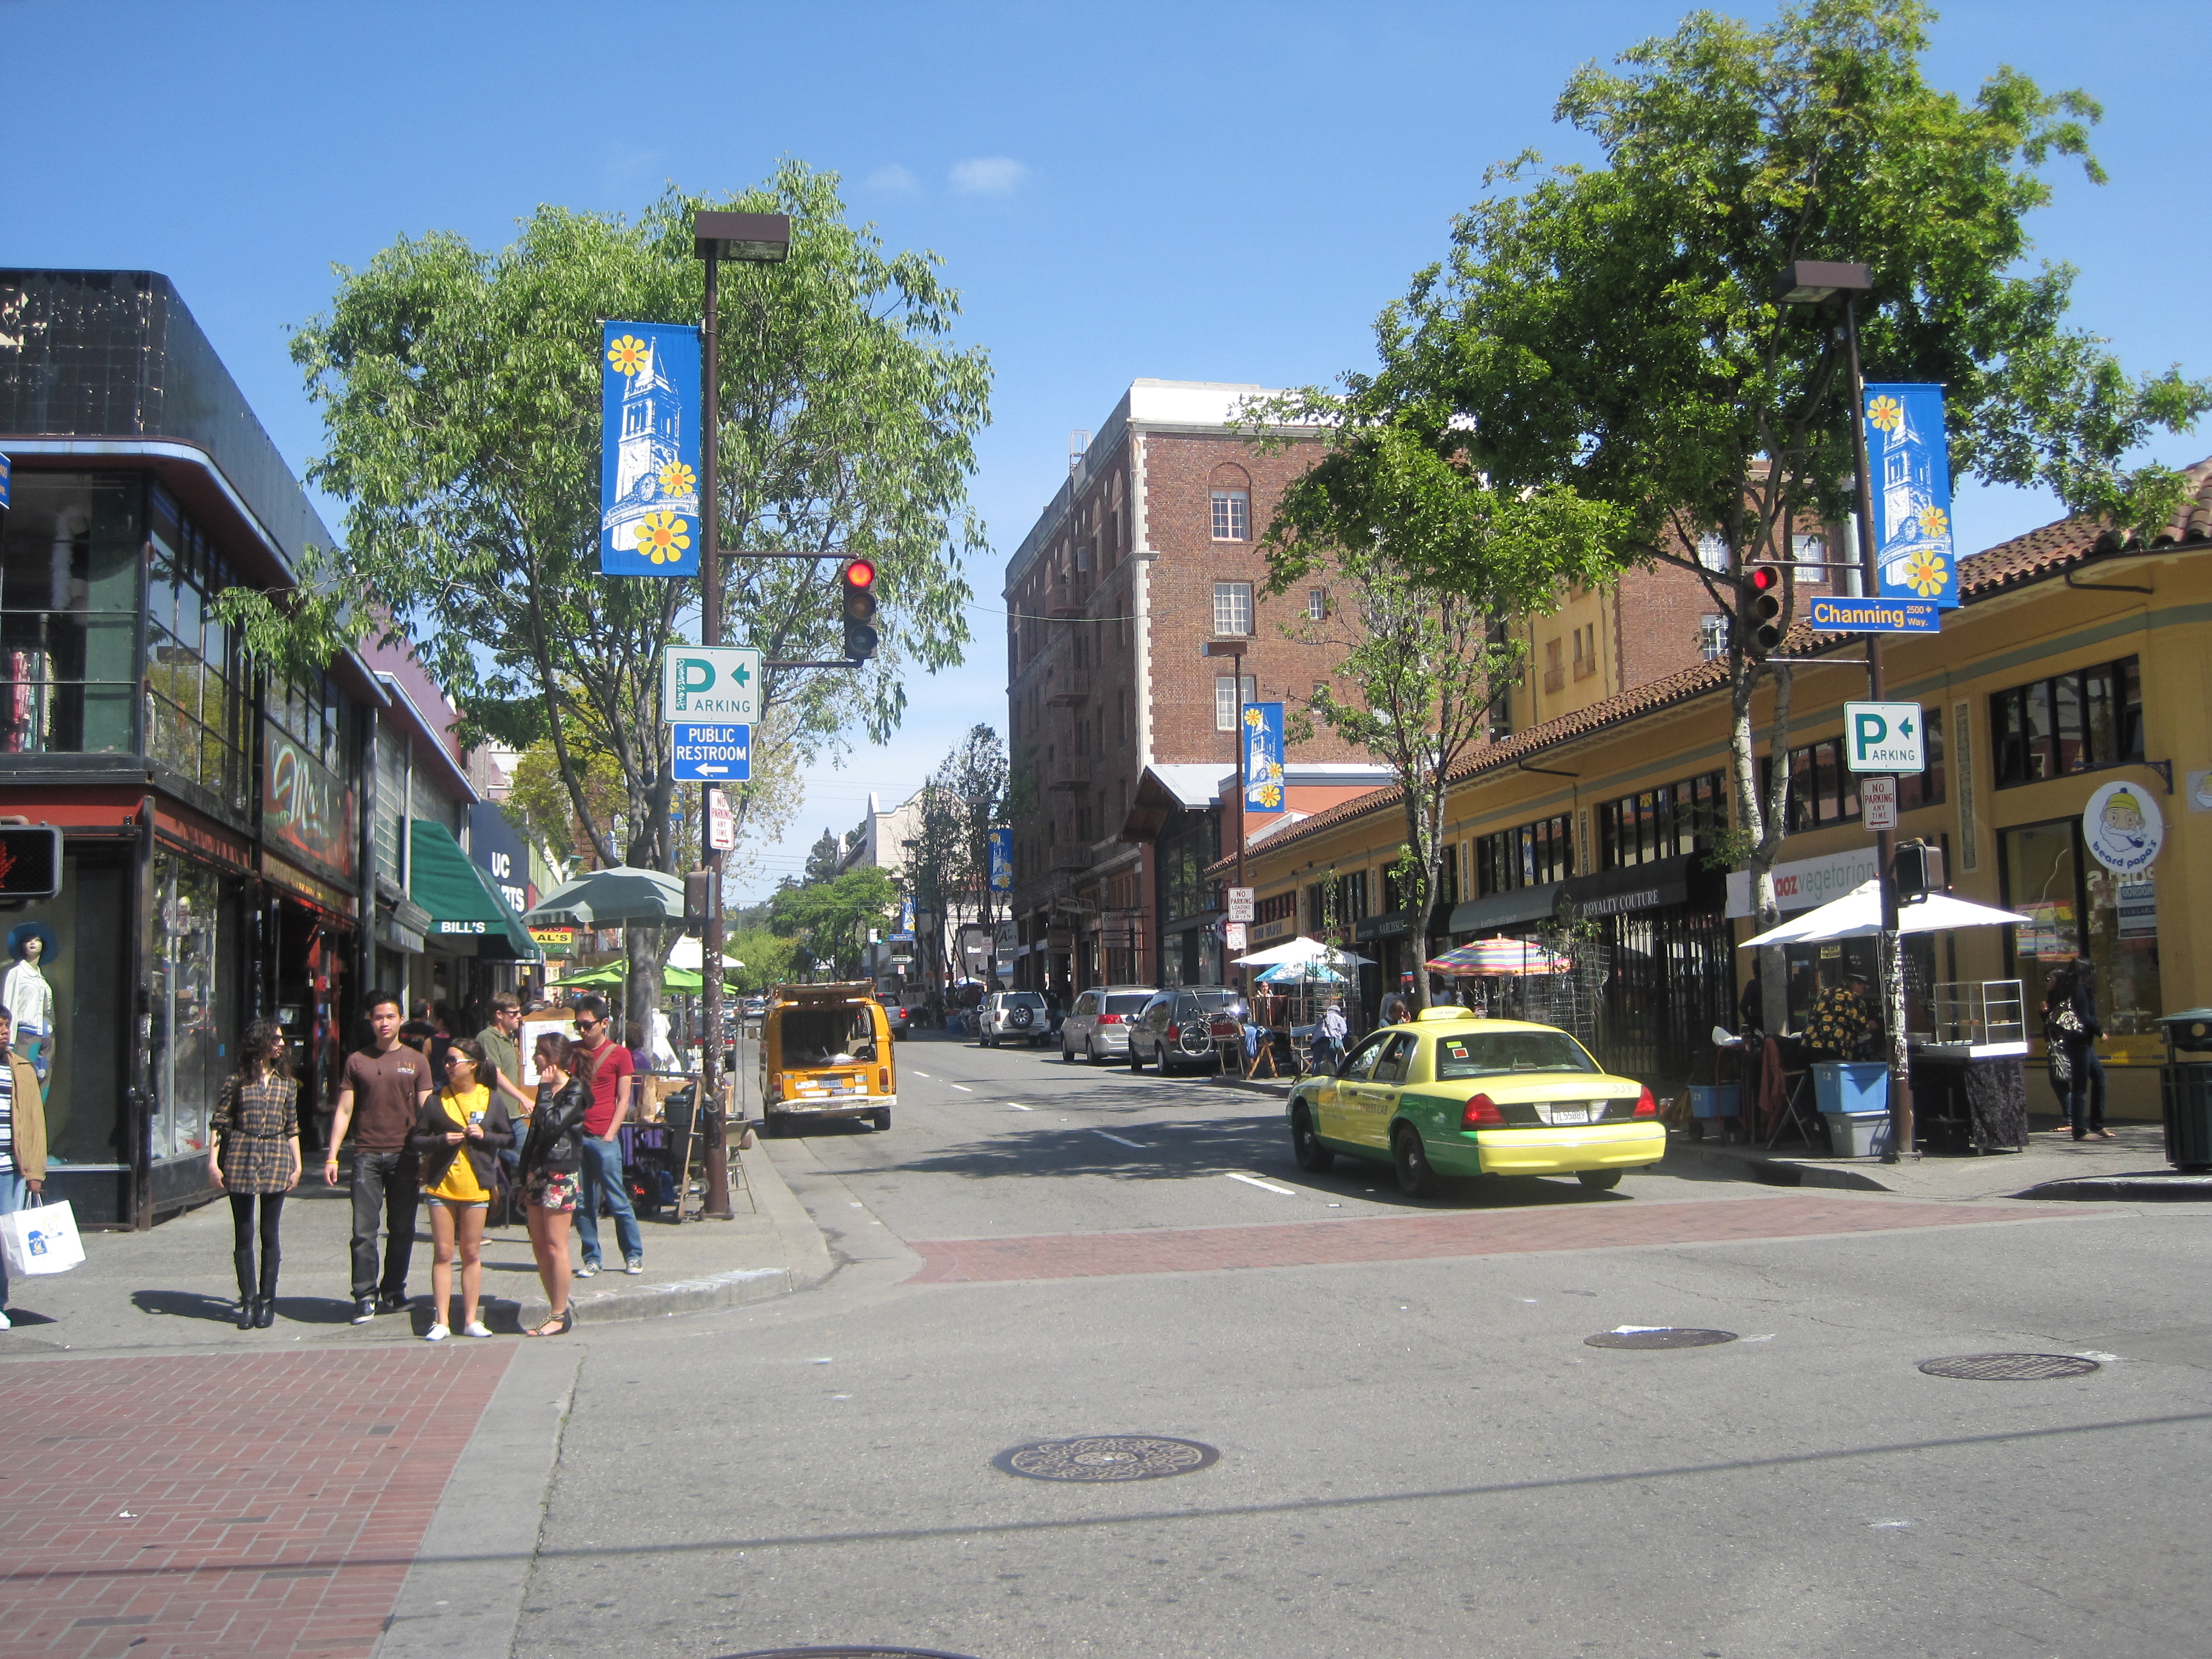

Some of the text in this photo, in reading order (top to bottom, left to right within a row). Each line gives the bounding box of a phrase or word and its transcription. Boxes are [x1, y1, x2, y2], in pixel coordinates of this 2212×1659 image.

[1814, 603, 1905, 628] Channing
[689, 728, 736, 743] PUBLIC
[677, 746, 746, 761] RESTROOM
[1872, 783, 1885, 793] NO
[717, 796, 726, 807] NO
[1865, 793, 1893, 804] PARKING
[712, 807, 731, 820] PARKING
[716, 828, 728, 837] TIME
[2093, 839, 2157, 869] beard papa's
[492, 851, 510, 879] UC
[1798, 856, 1874, 900] vegetarian
[1583, 890, 1660, 916] ROYALTY COUTURE
[441, 921, 486, 933] BILL'S
[1377, 1104, 1389, 1114] CAB
